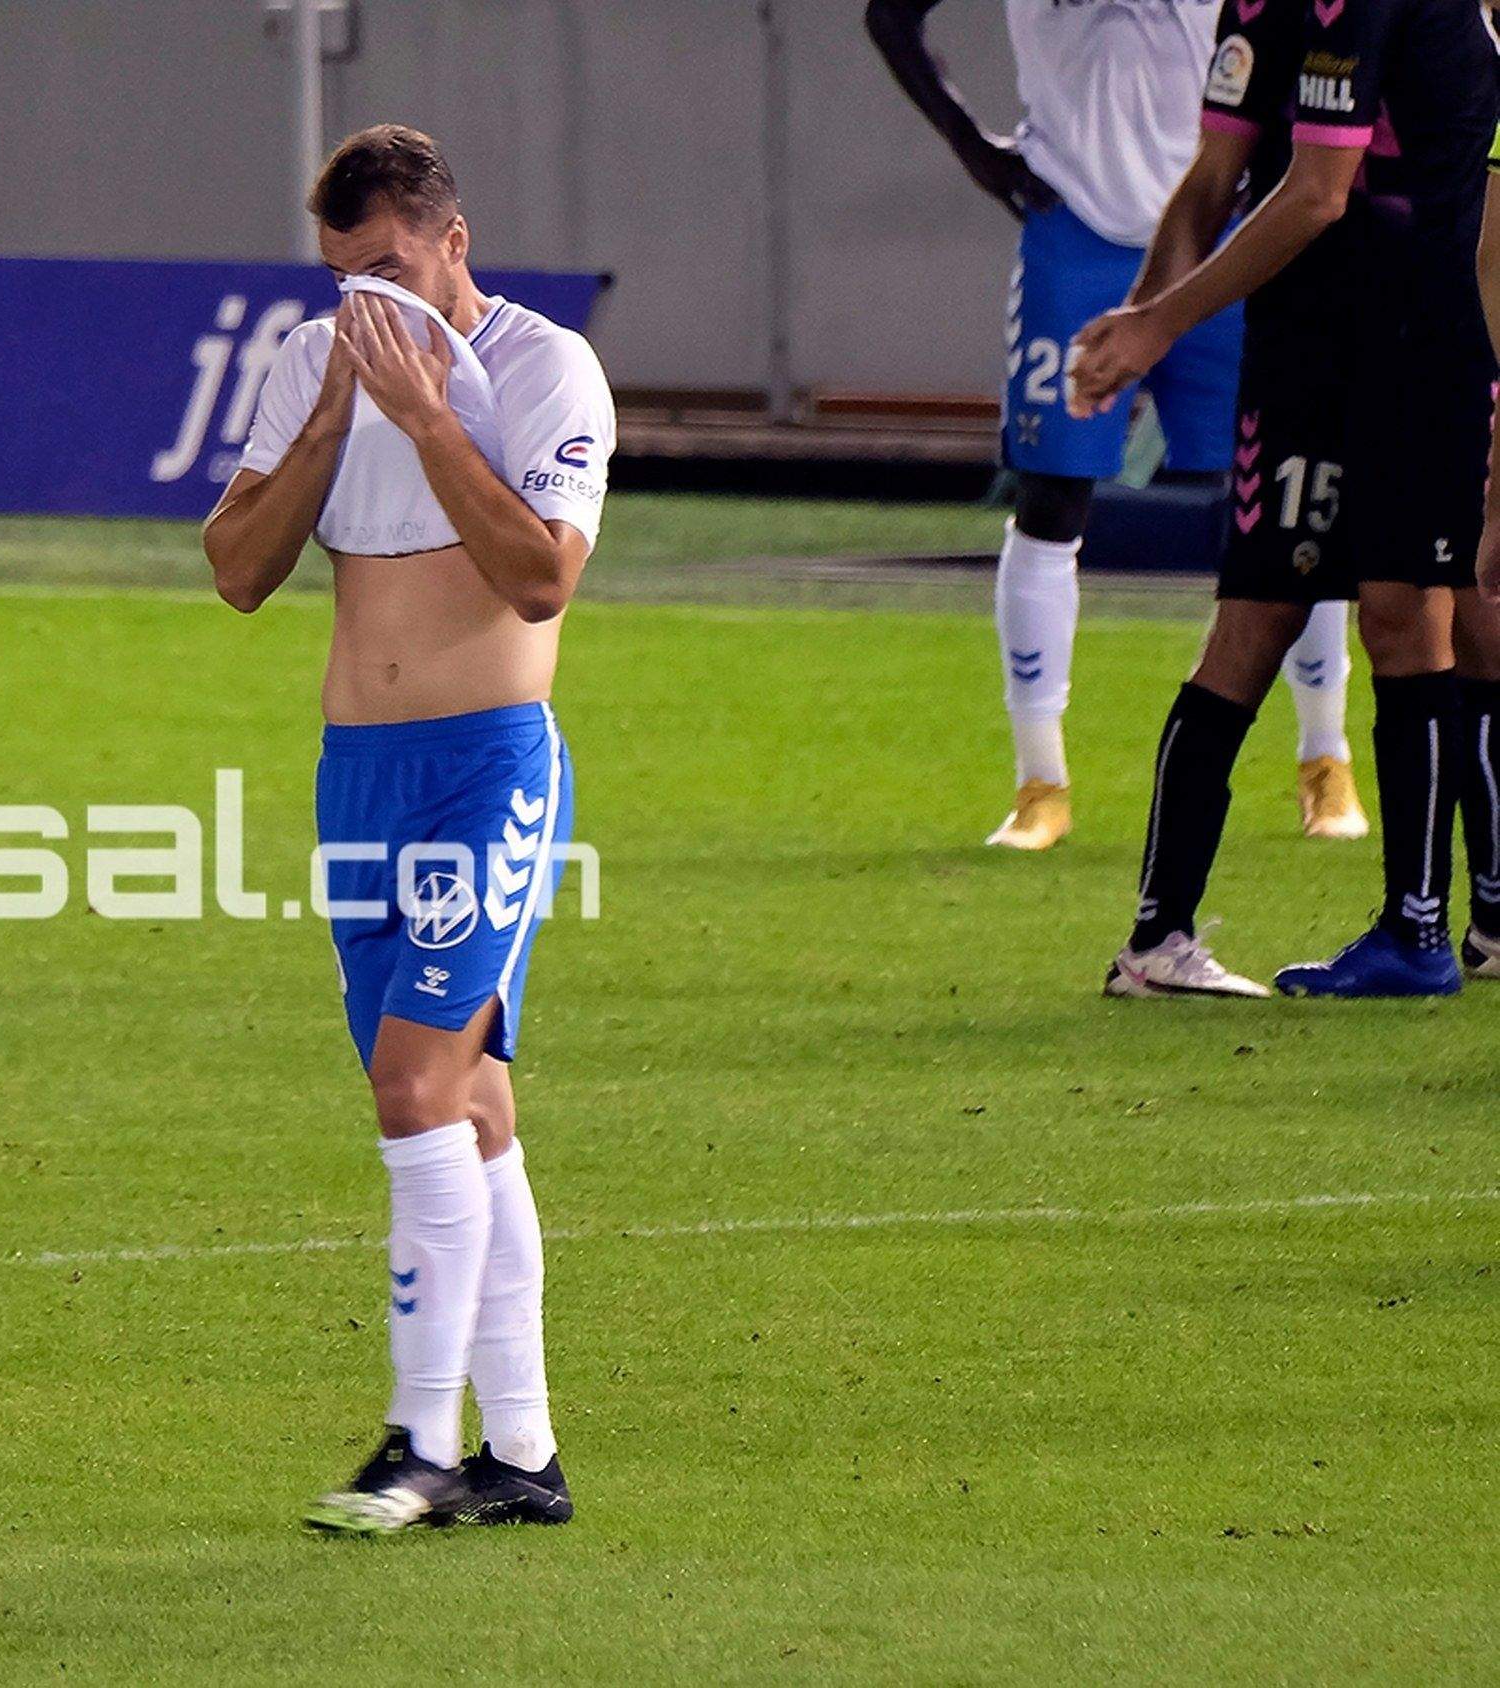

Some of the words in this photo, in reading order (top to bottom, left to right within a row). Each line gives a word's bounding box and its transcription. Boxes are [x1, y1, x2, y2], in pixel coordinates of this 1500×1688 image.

[1299, 73, 1355, 113] HILL
[150, 294, 306, 483] jf
[1275, 455, 1344, 532] 15
